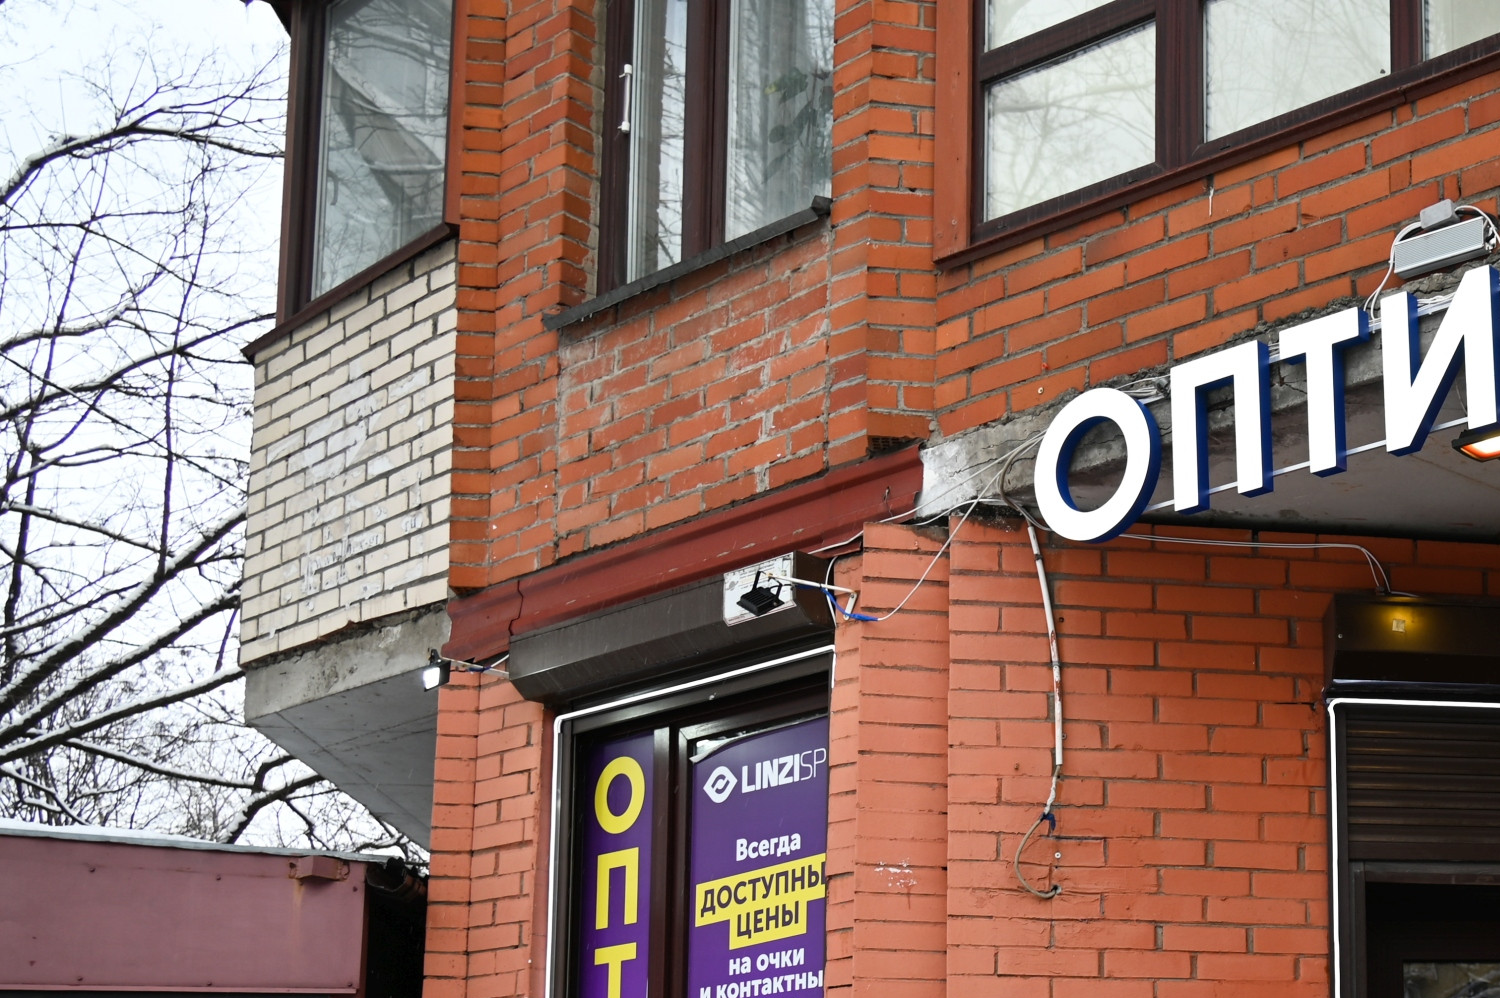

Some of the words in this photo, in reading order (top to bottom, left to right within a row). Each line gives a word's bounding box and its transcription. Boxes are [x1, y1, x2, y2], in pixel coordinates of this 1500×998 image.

[736, 833, 801, 861] Всегда
[737, 901, 799, 939] ЦЕНЫ
[729, 956, 751, 976] на
[756, 948, 805, 971] очки
